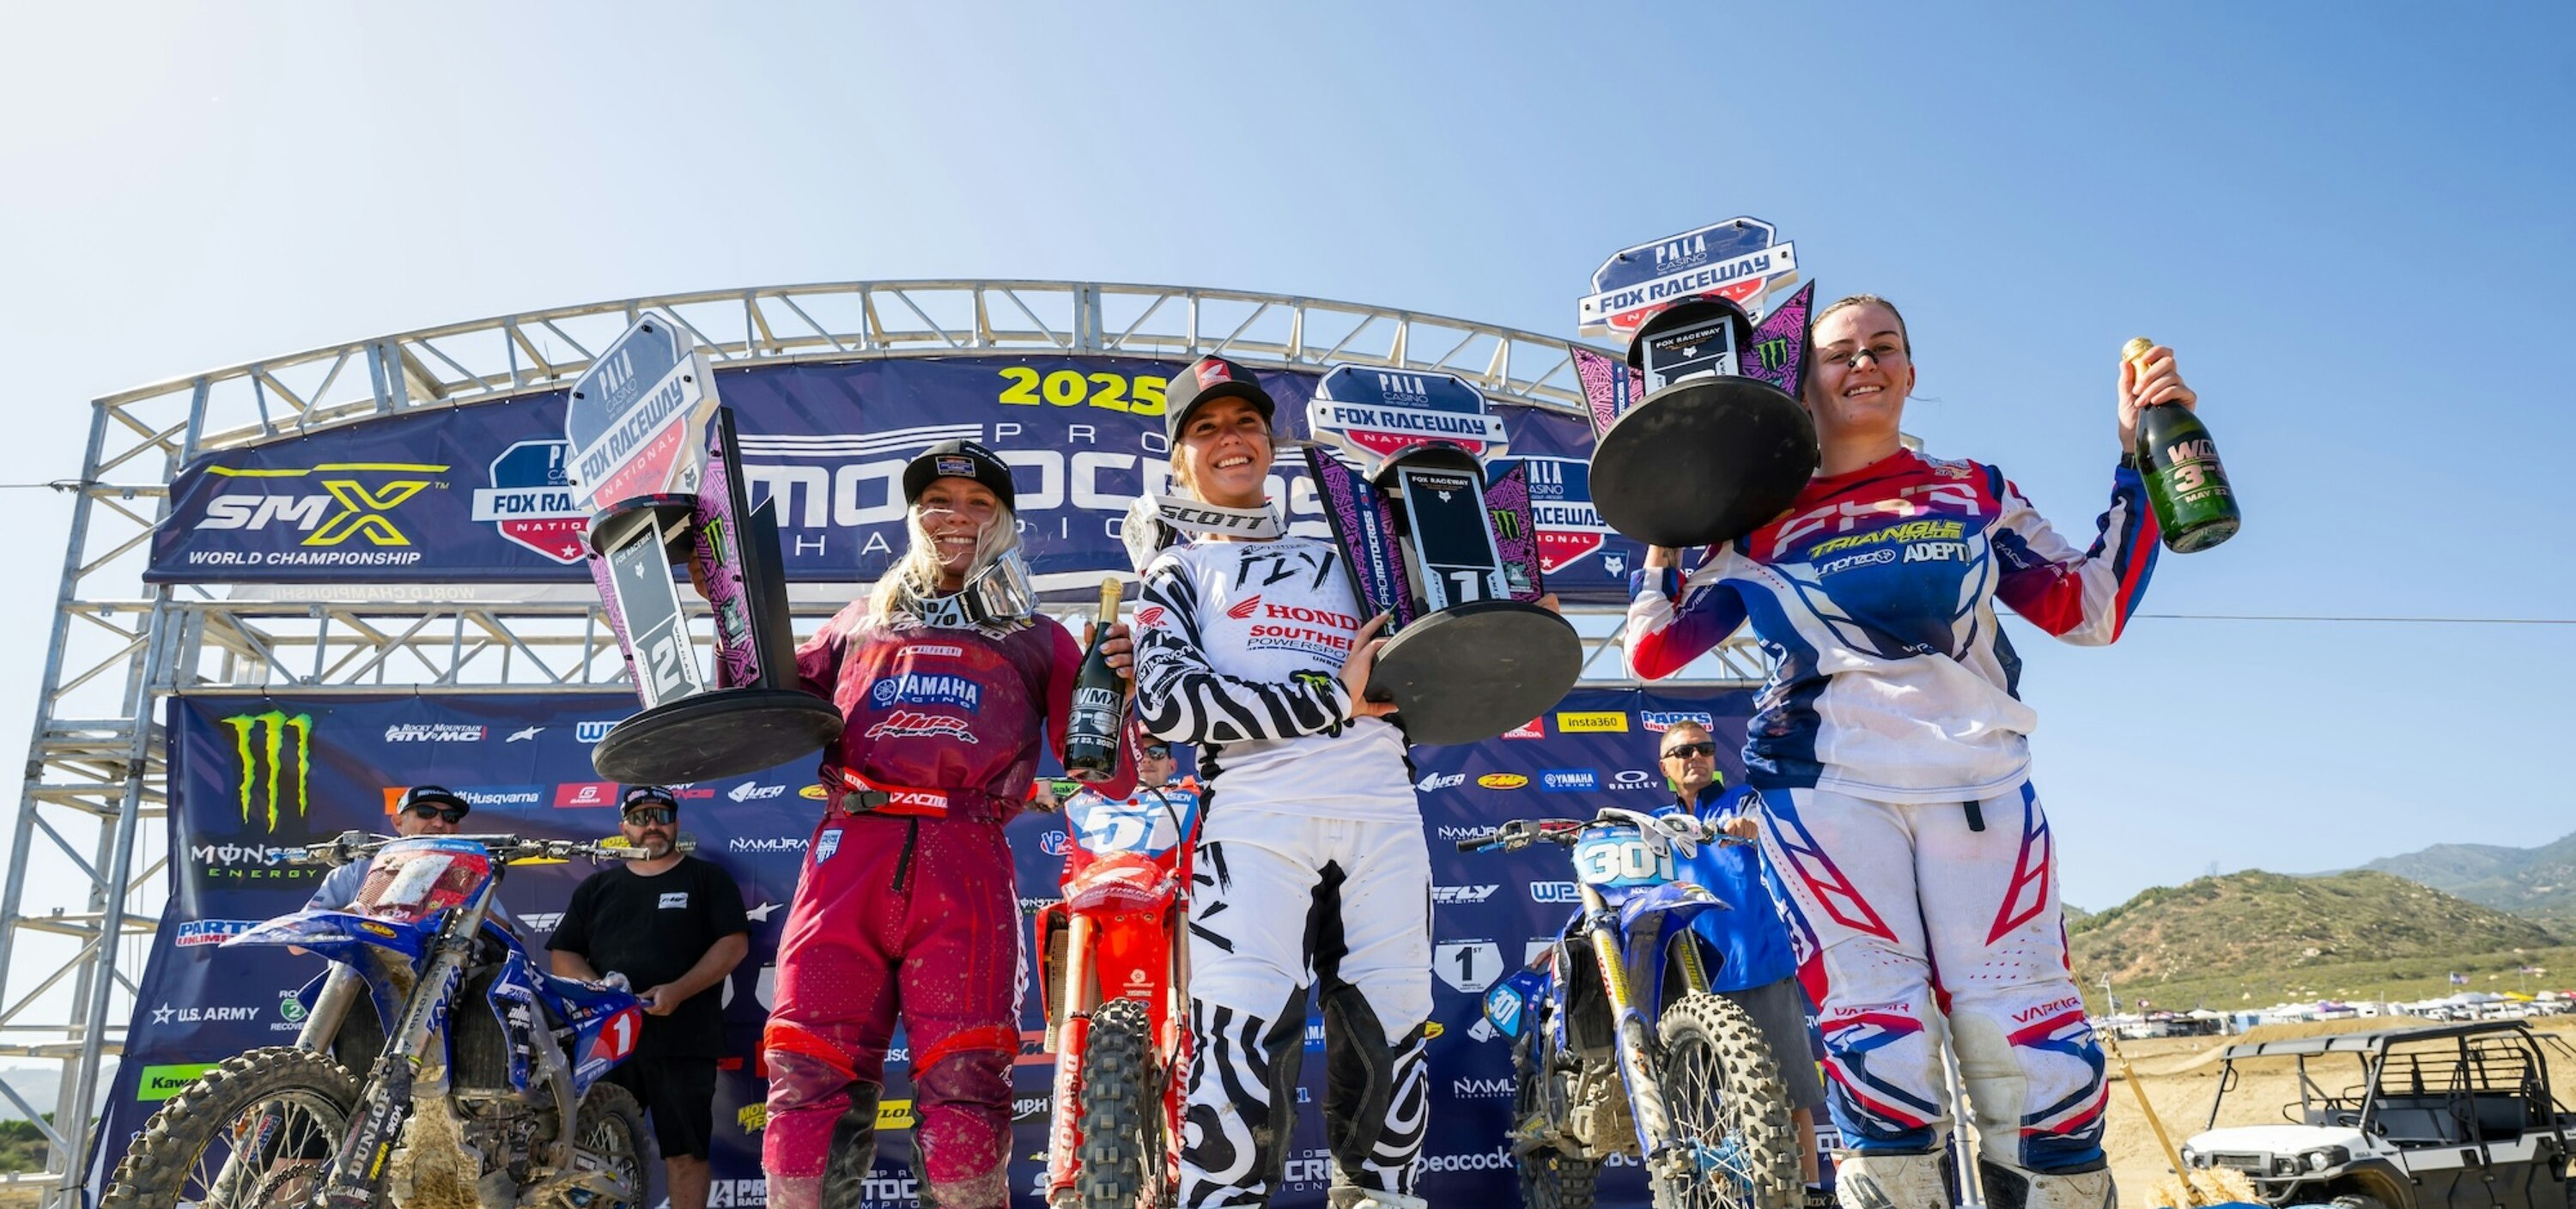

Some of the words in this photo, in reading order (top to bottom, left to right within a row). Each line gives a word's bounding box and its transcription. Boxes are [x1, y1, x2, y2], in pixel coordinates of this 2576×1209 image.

[1656, 235, 1706, 264] PALA
[1656, 252, 1707, 271] CASINO
[1601, 293, 1645, 313] FOX
[1649, 255, 1770, 300] RACEWAY
[1656, 338, 1674, 348] FOX
[1676, 327, 1720, 344] RACEWAY
[598, 348, 634, 400] PALA
[1378, 374, 1425, 394] PALA
[605, 378, 637, 412] CASINO
[999, 367, 1166, 416] 2025
[1382, 392, 1429, 404] CASINO
[580, 449, 612, 488] FOX
[613, 376, 684, 467] RACEWAY
[1334, 406, 1377, 427] FOX
[1381, 410, 1487, 435] RACEWAY
[605, 434, 676, 497] NATIONAL
[1530, 461, 1562, 483] ALA
[1431, 477, 1468, 486] RACEWAY
[1529, 483, 1564, 495] ASINO
[194, 480, 430, 545] SMX
[493, 494, 536, 514] FOX
[517, 520, 581, 532] NATIO
[1159, 505, 1267, 531] SCOTT
[615, 551, 627, 566] FOX
[627, 531, 655, 558] RACEWAY
[1536, 534, 1591, 544] IONAL
[1809, 519, 1965, 561] TRIANGLE
[188, 551, 262, 565] WORLD
[266, 551, 421, 566] CHAMPIONSHIP
[1903, 543, 1965, 564] ADEPT
[1264, 604, 1364, 632] HOND
[1248, 637, 1351, 659] POWERSPO
[1249, 624, 1356, 650] SOUTHE
[652, 635, 681, 697] 2
[898, 673, 977, 705] YAMAHA
[1643, 712, 1711, 724] PARTS
[1556, 774, 1594, 783] YAMAHA
[1609, 781, 1658, 790] OAKLEY
[466, 792, 539, 805] Husqvarna
[1078, 805, 1189, 854] 51
[1438, 824, 1498, 837] NAMUR
[729, 836, 810, 849] NAMURA
[208, 867, 318, 878] ENERGY
[1583, 841, 1674, 884] 301
[178, 1007, 201, 1021] U.S.
[203, 1006, 259, 1021] ARMY
[289, 1005, 301, 1018] 2
[1488, 988, 1522, 1026] 301
[612, 1012, 631, 1057] 1
[348, 1088, 390, 1180] DUNLOP
[1417, 1145, 1514, 1175] peacock
